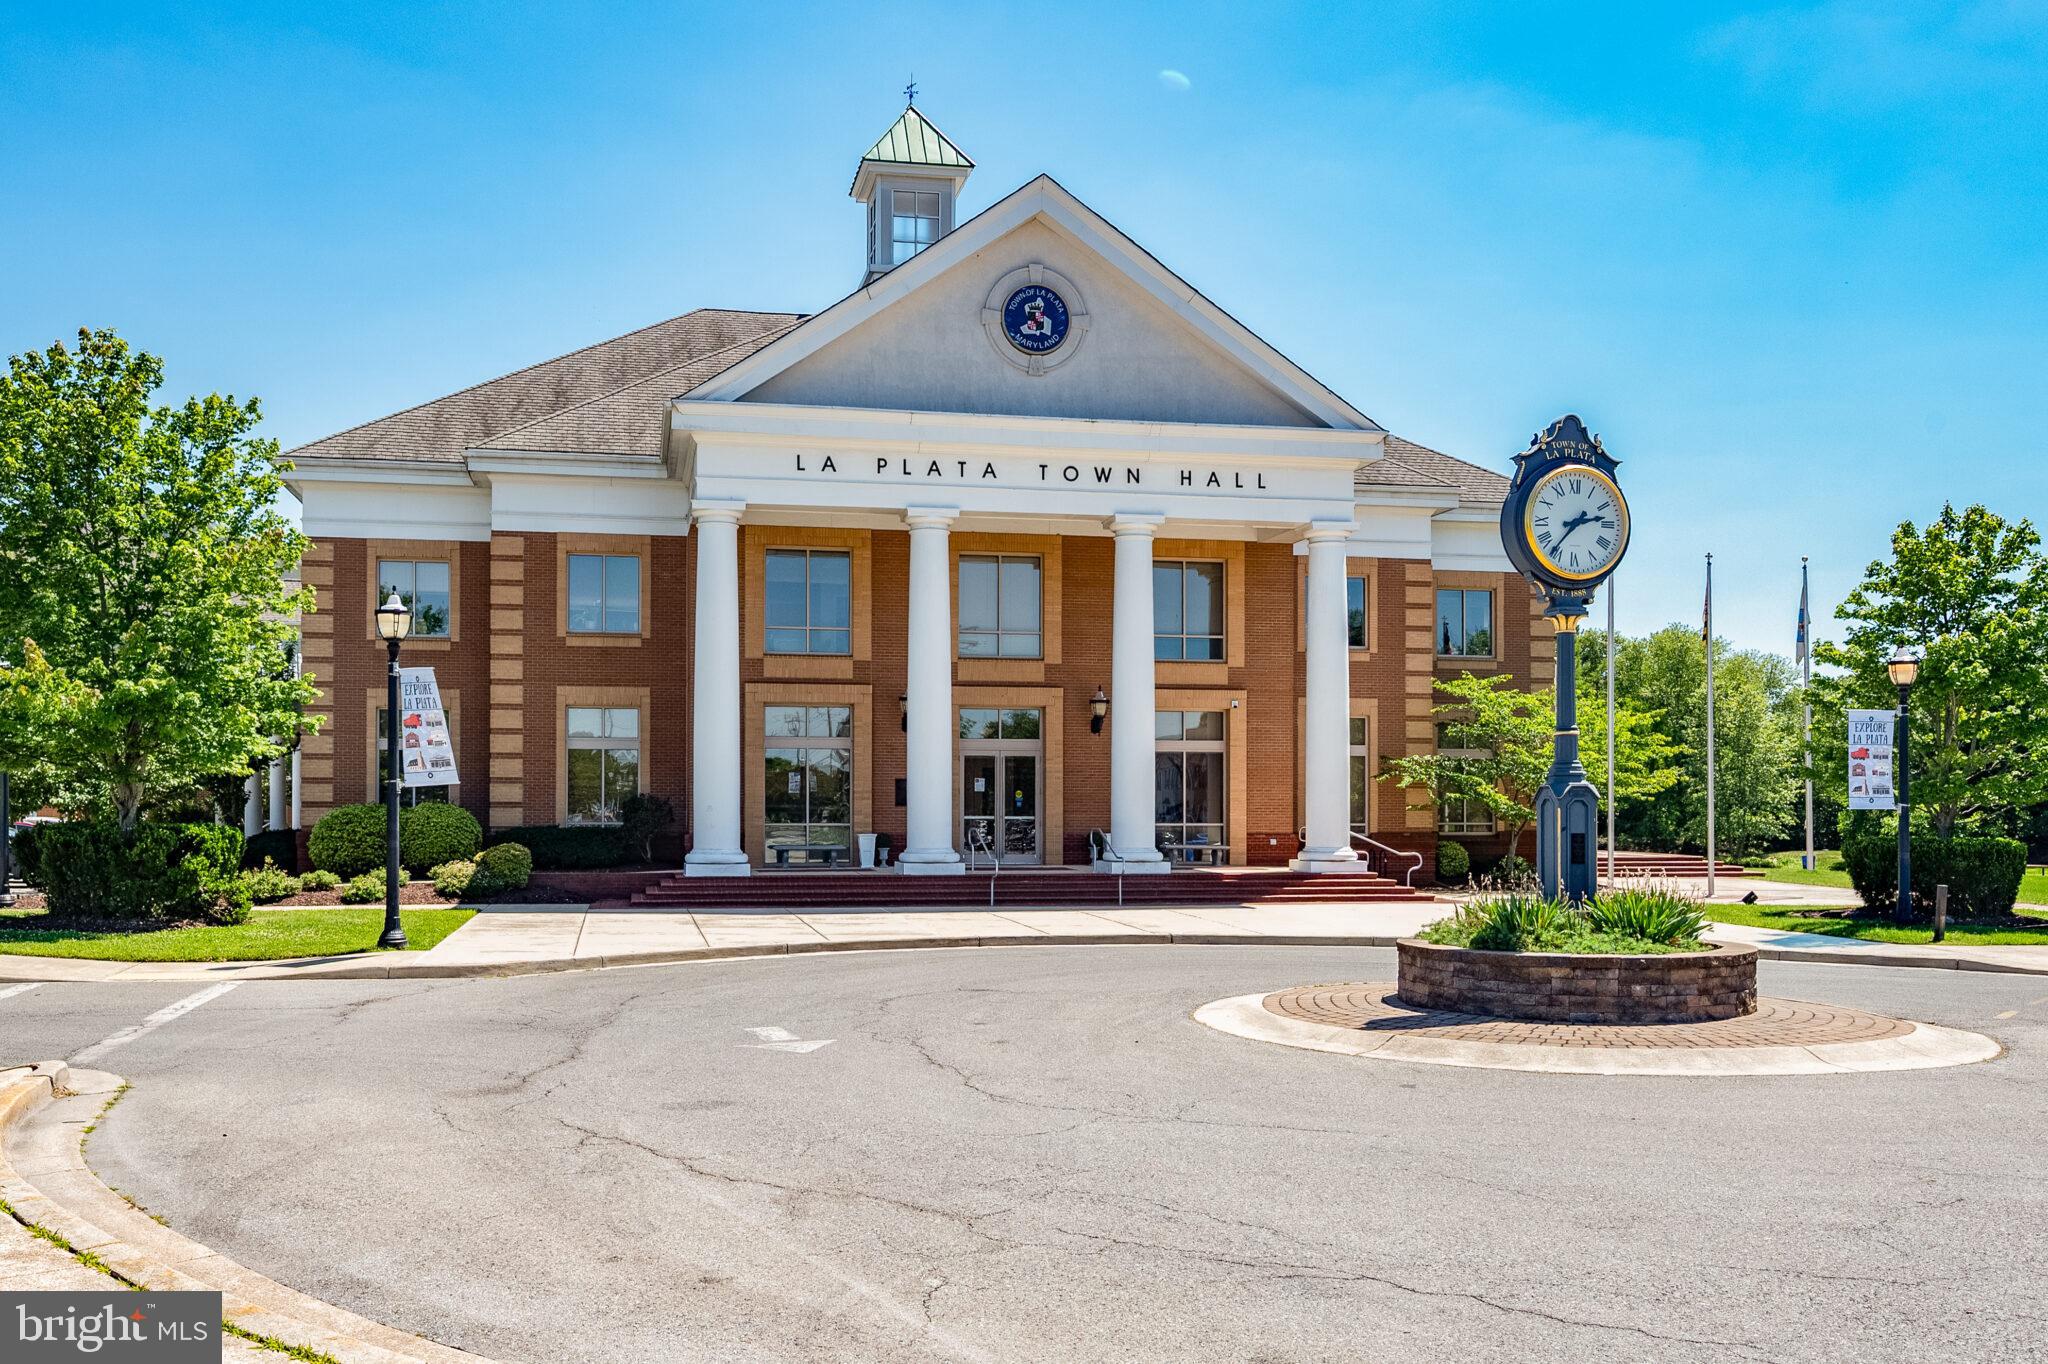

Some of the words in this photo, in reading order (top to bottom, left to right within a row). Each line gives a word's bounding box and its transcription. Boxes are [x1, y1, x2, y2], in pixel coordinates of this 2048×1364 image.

[1009, 292, 1026, 311] TOWN
[1047, 293, 1064, 312] PLATA
[1015, 334, 1060, 349] MARYLAND
[1551, 440, 1576, 449] TOWN
[1545, 450, 1560, 460] LA
[1564, 448, 1597, 464] PLATA
[796, 454, 837, 473] LA
[877, 457, 997, 480] PLATA
[1039, 464, 1141, 485] TOWN
[1180, 470, 1267, 490] HALL
[1552, 587, 1568, 597] EST.
[1571, 589, 1587, 597] 1888
[405, 684, 433, 695] EXPLORE
[404, 698, 412, 709] LA
[416, 697, 437, 709] PLATA
[1855, 722, 1887, 733] EXPLORE
[1853, 734, 1862, 744] LA
[1866, 734, 1888, 744] PLATA
